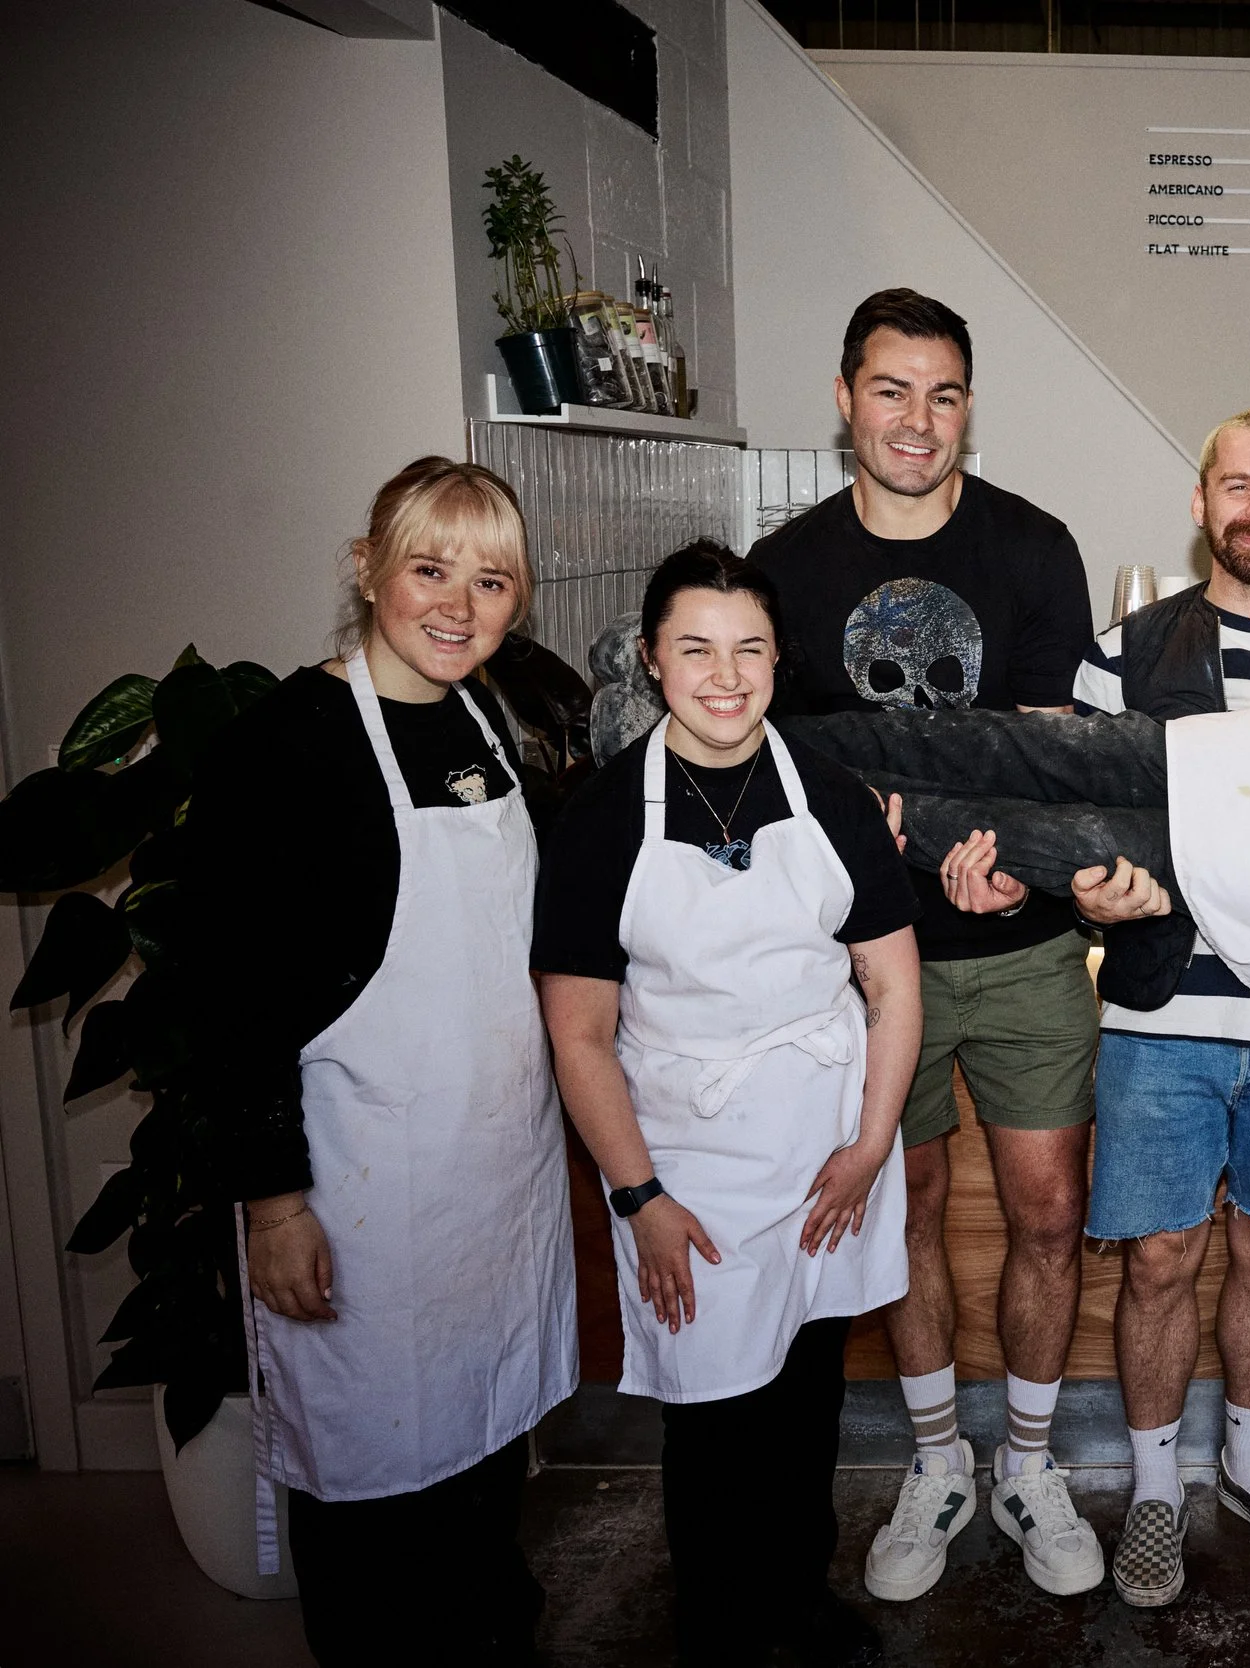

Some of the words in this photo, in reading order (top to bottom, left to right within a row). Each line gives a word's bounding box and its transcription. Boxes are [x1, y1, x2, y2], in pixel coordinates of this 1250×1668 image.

[1150, 154, 1212, 166] ESPRESSO
[1149, 184, 1223, 196] AMERICANO
[1149, 215, 1203, 225] PICCOLO
[1149, 244, 1179, 254] FLAT
[1188, 246, 1228, 256] WHITE
